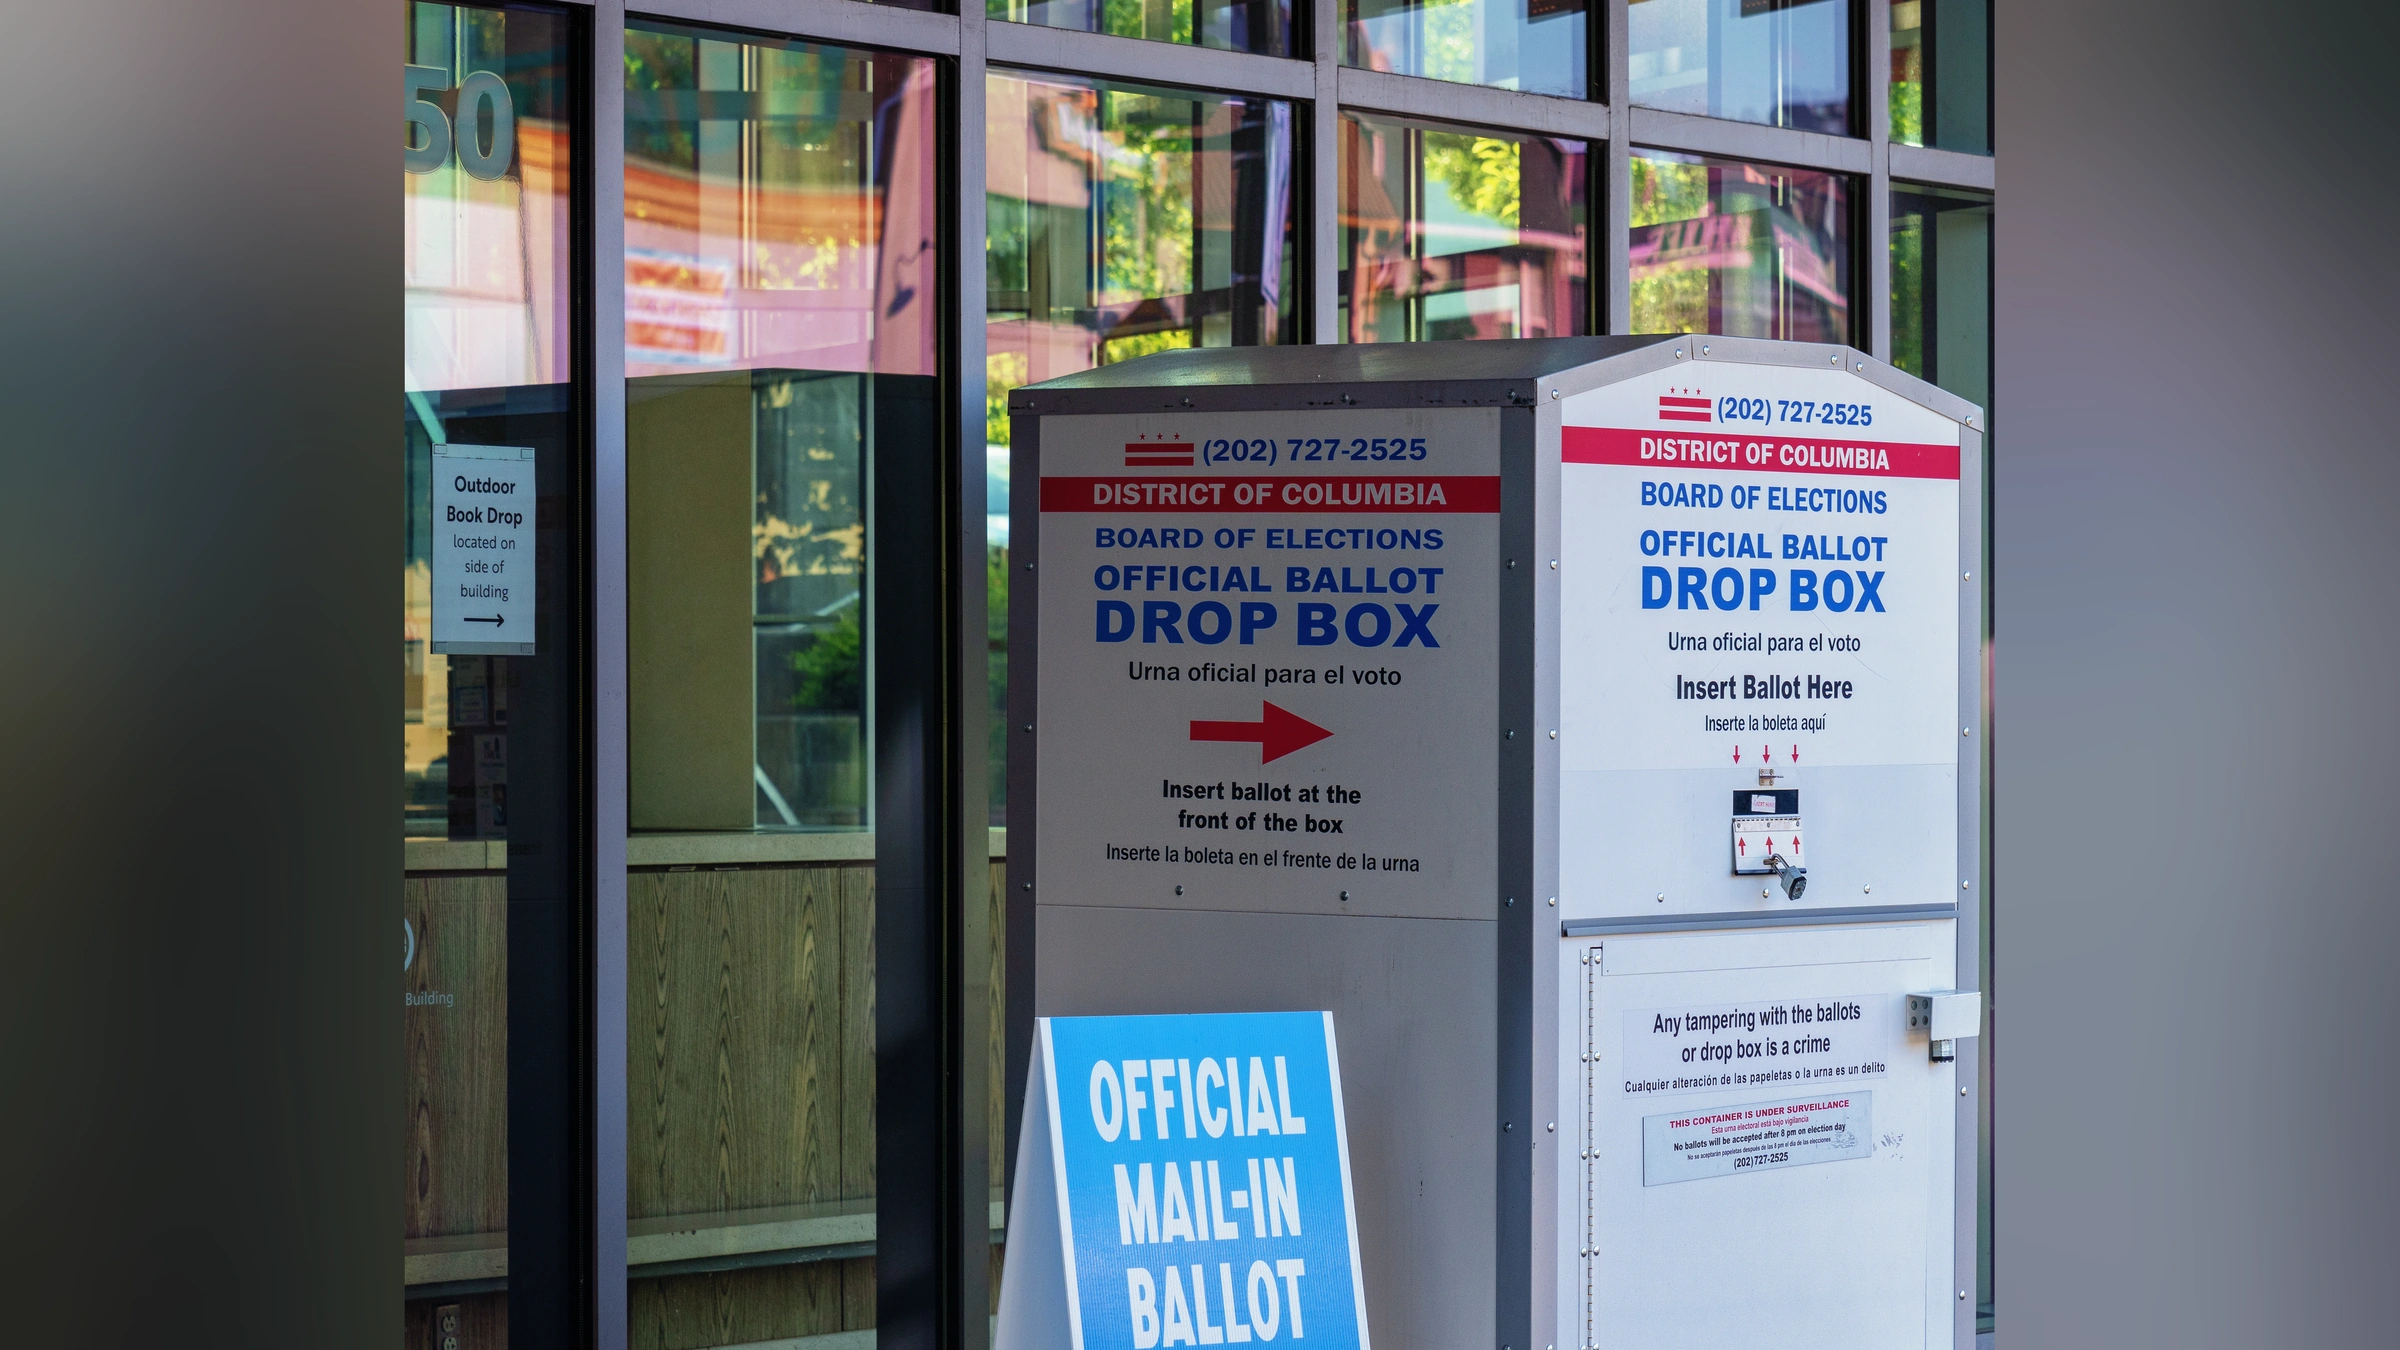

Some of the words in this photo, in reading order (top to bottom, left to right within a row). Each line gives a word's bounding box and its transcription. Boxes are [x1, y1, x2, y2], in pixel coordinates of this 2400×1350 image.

[1718, 397, 1771, 425] (202)
[1778, 400, 1872, 426] 727-2525
[1203, 439, 1277, 466] (202)
[1287, 438, 1426, 461] 727-2525
[1641, 438, 1740, 463] DISTRICT
[1746, 443, 1773, 464] OF
[1780, 445, 1889, 470] COLUMBIA
[455, 476, 515, 494] Outdoor
[1094, 483, 1225, 505] DISTRICT
[1234, 483, 1273, 505] OF
[1282, 483, 1447, 505] COLUMBIA
[1642, 482, 1723, 508] BOARD
[1731, 485, 1761, 509] OF
[1768, 487, 1887, 514] ELECTIONS
[447, 506, 482, 523] Book
[488, 507, 522, 529] Drop
[454, 534, 496, 549] located
[501, 540, 515, 549] on
[1096, 528, 1203, 548] BOARD
[1214, 528, 1255, 548] OF
[1267, 529, 1443, 550] ELECTIONS
[1640, 530, 1772, 559] OFFICIAL
[1783, 534, 1887, 561] BALLOT
[465, 560, 488, 573] side
[492, 560, 504, 573] of
[1094, 565, 1271, 592] OFFICIAL
[1287, 567, 1443, 594] BALLOT
[461, 584, 508, 602] building
[1642, 566, 1776, 611] DROP
[1790, 569, 1886, 612] BOX
[1096, 600, 1277, 644] DROP
[1297, 603, 1440, 648] BOX
[1669, 632, 1706, 650] Urna
[1713, 632, 1761, 651] oficial
[1768, 637, 1803, 655] para
[1809, 633, 1822, 651] el
[1828, 635, 1860, 651] voto
[1130, 662, 1179, 681] Urna
[1188, 663, 1255, 682] oficial
[1265, 669, 1315, 687] para
[1325, 665, 1343, 684] el
[1352, 667, 1401, 685] voto
[1677, 675, 1736, 699] Insert
[1744, 675, 1800, 699] Ballot
[1808, 675, 1852, 699] Here
[1706, 715, 1745, 731] Inserte
[1749, 715, 1758, 731] la
[1763, 715, 1797, 730] boleta
[1802, 713, 1826, 733] aquí
[1163, 780, 1224, 799] Insert
[1232, 782, 1291, 802] ballot
[1299, 785, 1319, 803] at
[1327, 785, 1361, 804] the
[1178, 809, 1228, 829] front
[1236, 812, 1256, 830] of
[1264, 813, 1297, 832] the
[1306, 814, 1343, 833] box
[1107, 843, 1160, 861] Inserte
[1166, 846, 1178, 862] la
[1185, 846, 1233, 864] boleta
[1239, 853, 1258, 865] en
[1264, 850, 1277, 866] el
[1283, 850, 1331, 868] frente
[1337, 853, 1356, 869] de
[1363, 853, 1376, 870] la
[1383, 858, 1419, 872] urna
[405, 991, 454, 1007] Building
[1653, 1014, 1681, 1037] Any
[1686, 1009, 1755, 1034] tampering
[1760, 1006, 1787, 1026] with
[1792, 1005, 1812, 1024] the
[1817, 1002, 1860, 1022] ballots
[1682, 1046, 1697, 1063] or
[1701, 1042, 1732, 1064] drop
[1737, 1039, 1761, 1058] box
[1767, 1037, 1777, 1056] is
[1782, 1041, 1789, 1055] a
[1794, 1034, 1830, 1054] crime
[1625, 1079, 1669, 1093] Cualquier
[1673, 1075, 1717, 1089] alteración
[1721, 1074, 1731, 1085] de
[1735, 1073, 1746, 1084] las
[1750, 1070, 1792, 1085] papeletas
[1795, 1071, 1800, 1079] o
[1804, 1067, 1810, 1078] la
[1814, 1068, 1832, 1077] urna
[1836, 1067, 1845, 1075] es
[1849, 1066, 1858, 1074] un
[1862, 1062, 1885, 1073] delito
[1090, 1056, 1306, 1142] OFFICIAL
[1670, 1119, 1690, 1128] THIS
[1692, 1112, 1743, 1126] CONTAINER
[1756, 1107, 1784, 1117] UNDER
[1787, 1100, 1849, 1113] SURVEILLANCE
[1737, 1121, 1759, 1130] electoral
[1773, 1118, 1784, 1127] bajo
[1785, 1117, 1808, 1126] vigilancia
[1674, 1143, 1683, 1151] No
[1685, 1140, 1707, 1149] ballots
[1709, 1137, 1720, 1146] will
[1732, 1132, 1762, 1143] accepted
[1764, 1131, 1779, 1139] after
[1781, 1129, 1785, 1137] 8
[1787, 1130, 1796, 1138] pm
[1808, 1124, 1833, 1133] election
[1835, 1123, 1846, 1133] day
[1722, 1149, 1742, 1157] papeletas
[1114, 1157, 1301, 1245] MAIL-IN
[1127, 1259, 1305, 1349] BALLOT
